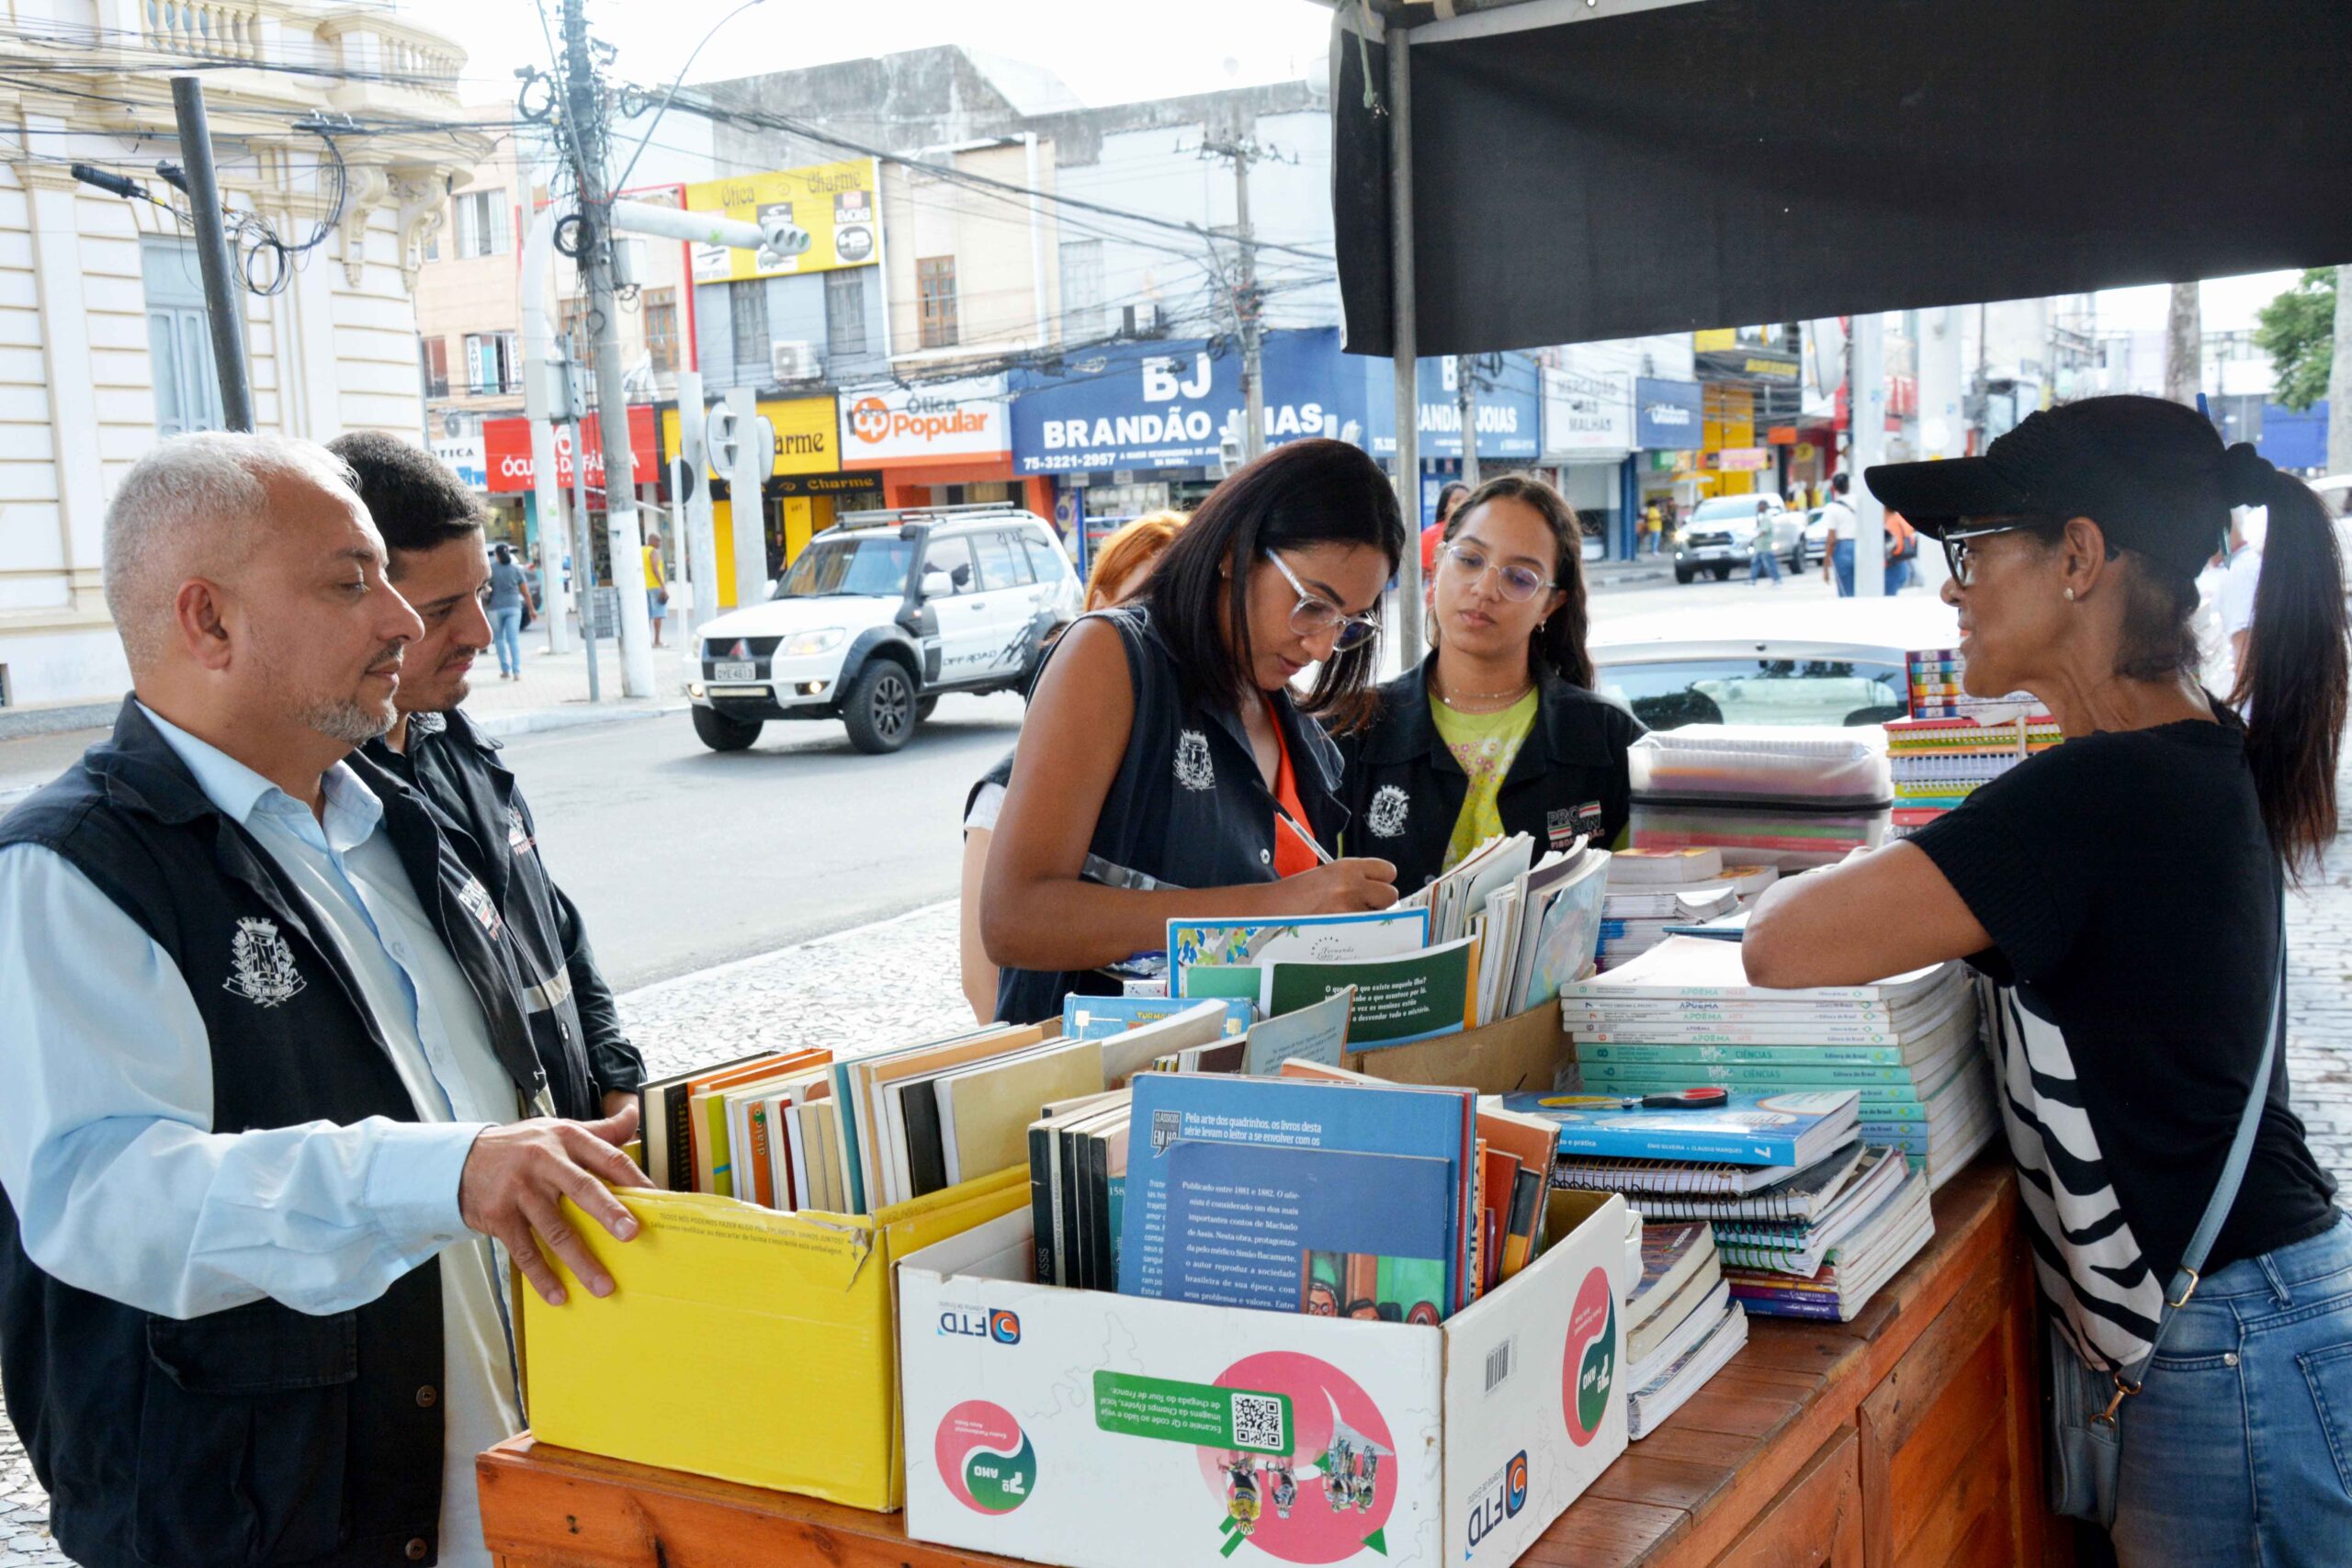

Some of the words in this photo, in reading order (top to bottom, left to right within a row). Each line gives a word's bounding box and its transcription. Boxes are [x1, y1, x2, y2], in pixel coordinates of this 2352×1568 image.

[806, 171, 862, 194] Charme
[1142, 353, 1213, 402] BJ
[1475, 404, 1518, 434] JOIAS
[893, 411, 989, 441] Popular
[1044, 406, 1212, 450] BRANDÃO
[1218, 402, 1324, 439] JIAS
[774, 431, 825, 456] arme
[807, 475, 875, 491] Charme
[1372, 983, 1390, 992] existe
[1680, 987, 1719, 997] APOEMA
[1679, 1001, 1719, 1010] APOEMA
[1358, 1012, 1387, 1022] desvendar
[1683, 1013, 1723, 1021] APOEMA
[1691, 1034, 1731, 1043] APOEMA
[1735, 1048, 1773, 1059] CIÊNCIAS
[1743, 1067, 1781, 1078] CIÊNCIAS
[1185, 1112, 1200, 1123] Pela
[1200, 1115, 1216, 1124] arte
[1216, 1115, 1228, 1125] dos
[1228, 1117, 1271, 1129] quadrinhos,
[1271, 1120, 1281, 1129] os
[1281, 1120, 1303, 1132] livros
[1304, 1122, 1322, 1134] desta
[1153, 1132, 1165, 1147] EM
[1184, 1125, 1201, 1136] série
[1201, 1127, 1223, 1138] levam
[1228, 1128, 1248, 1140] leitor
[1253, 1133, 1262, 1141] se
[1262, 1132, 1295, 1145] envolver
[1295, 1135, 1310, 1145] com
[1311, 1136, 1320, 1145] os
[1573, 1138, 1597, 1149] prática
[1182, 1180, 1215, 1192] Publicado
[1216, 1185, 1233, 1193] entre
[1211, 1200, 1253, 1212] considerado
[1267, 1205, 1281, 1213] dos
[1282, 1206, 1298, 1215] mais
[718, 1220, 737, 1230] FAZER
[1188, 1213, 1228, 1224] importantes
[1229, 1218, 1253, 1227] contos
[1254, 1219, 1264, 1228] de
[1265, 1221, 1298, 1232] Machado
[716, 1230, 741, 1240] descartar
[1187, 1228, 1196, 1236] de
[1216, 1231, 1235, 1240] Nesta
[1254, 1235, 1298, 1247] protagoniza-
[1186, 1244, 1196, 1253] da
[1195, 1245, 1210, 1256] pelo
[1210, 1246, 1236, 1256] médico
[1236, 1249, 1257, 1259] Simão
[1039, 1247, 1050, 1277] ASSIS
[1193, 1260, 1212, 1269] autor
[1215, 1263, 1248, 1274] reproduz
[1257, 1267, 1296, 1279] sociedade
[1185, 1274, 1220, 1286] brasileira
[1222, 1279, 1232, 1287] de
[1234, 1281, 1248, 1290] sua
[1278, 1286, 1295, 1294] com
[1184, 1291, 1200, 1299] seus
[1201, 1292, 1238, 1304] problemas
[1245, 1296, 1272, 1308] valores.
[1275, 1301, 1295, 1310] Entre
[940, 1312, 988, 1337] FTD
[1583, 1364, 1597, 1391] ANO
[1100, 1396, 1117, 1408] local
[1136, 1391, 1148, 1401] de
[1148, 1392, 1165, 1404] Tour
[1166, 1394, 1177, 1404] do
[1177, 1396, 1210, 1410] chegada
[1210, 1400, 1221, 1410] de
[1101, 1408, 1116, 1418] veja
[1150, 1404, 1178, 1417] Champs
[1178, 1408, 1188, 1417] da
[1190, 1409, 1221, 1421] imagens
[1123, 1412, 1140, 1423] lado
[1151, 1416, 1170, 1427] code
[1171, 1418, 1182, 1429] Qr
[1189, 1421, 1222, 1434] Escaneie
[974, 1465, 999, 1479] ANO
[1468, 1484, 1504, 1548] FTD
